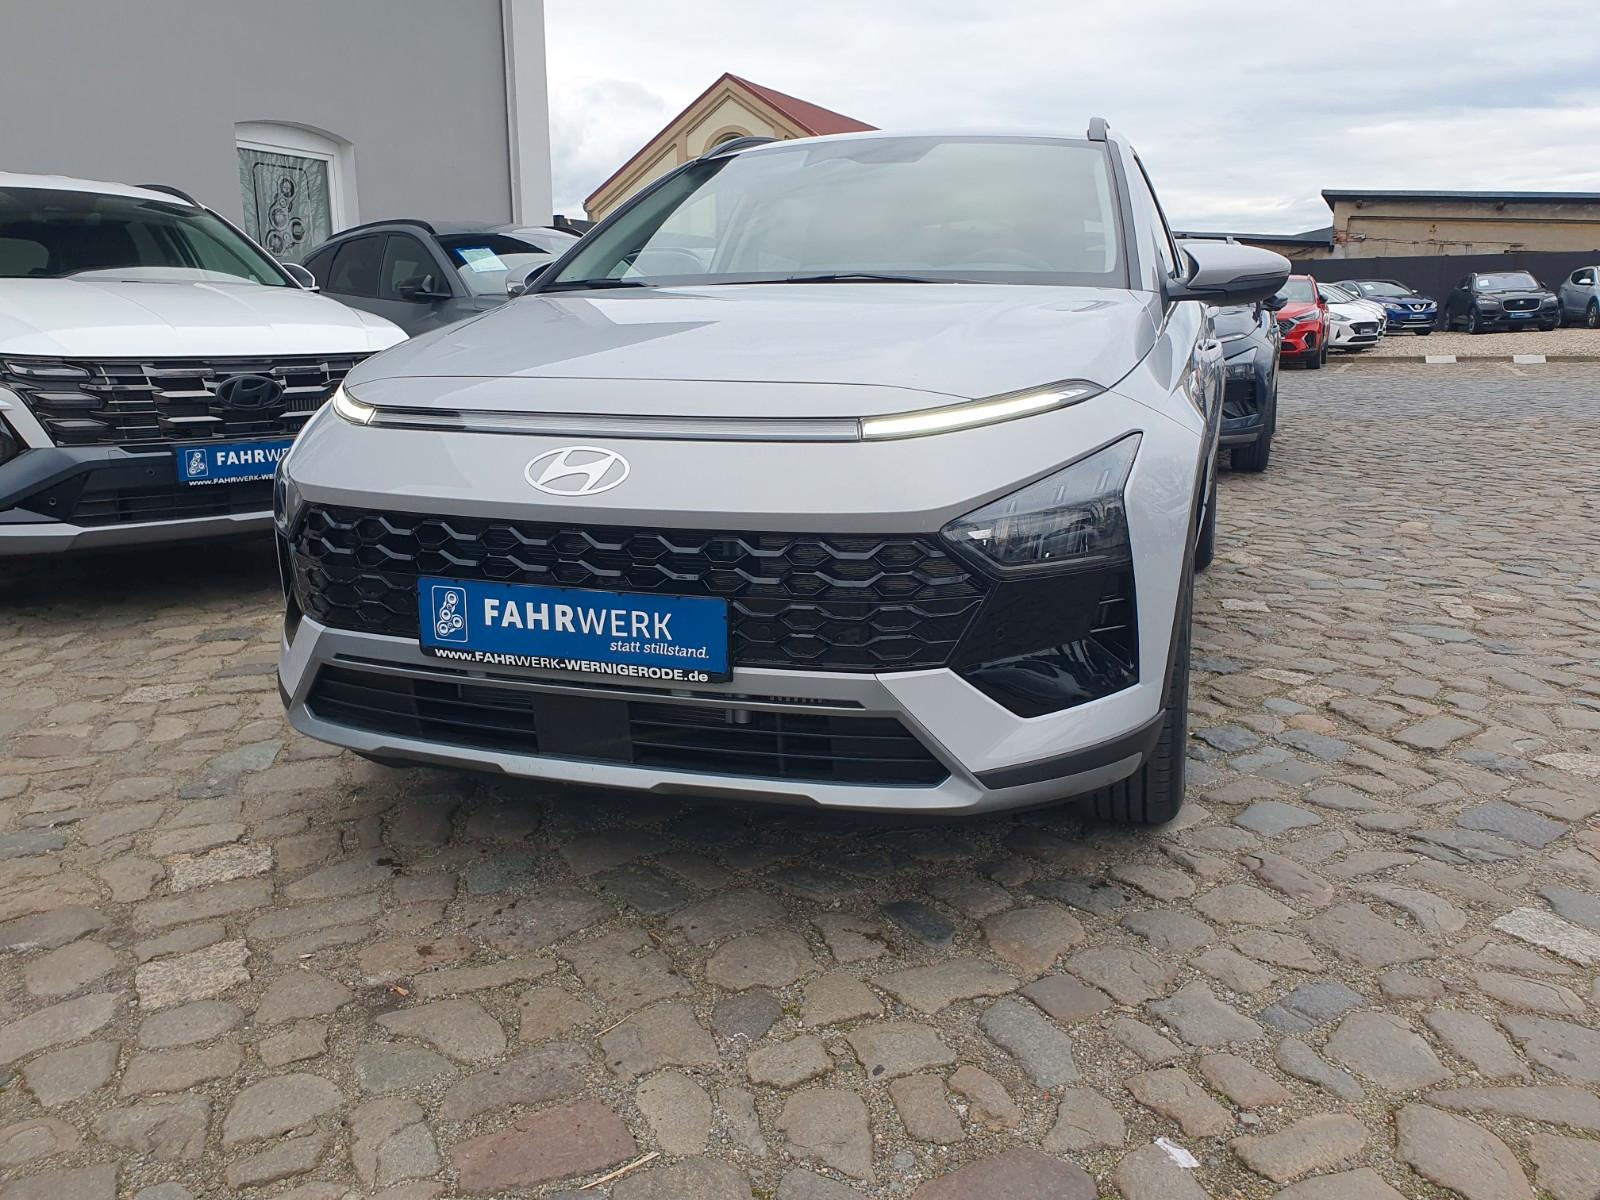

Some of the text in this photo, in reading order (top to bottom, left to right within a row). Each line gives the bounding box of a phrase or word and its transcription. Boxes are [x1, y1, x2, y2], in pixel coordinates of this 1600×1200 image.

[484, 598, 673, 640] FAHRWERK
[434, 648, 709, 683] www.FAHRWERK-WERNIGERODE.de
[609, 640, 710, 659] statt stillstand.
